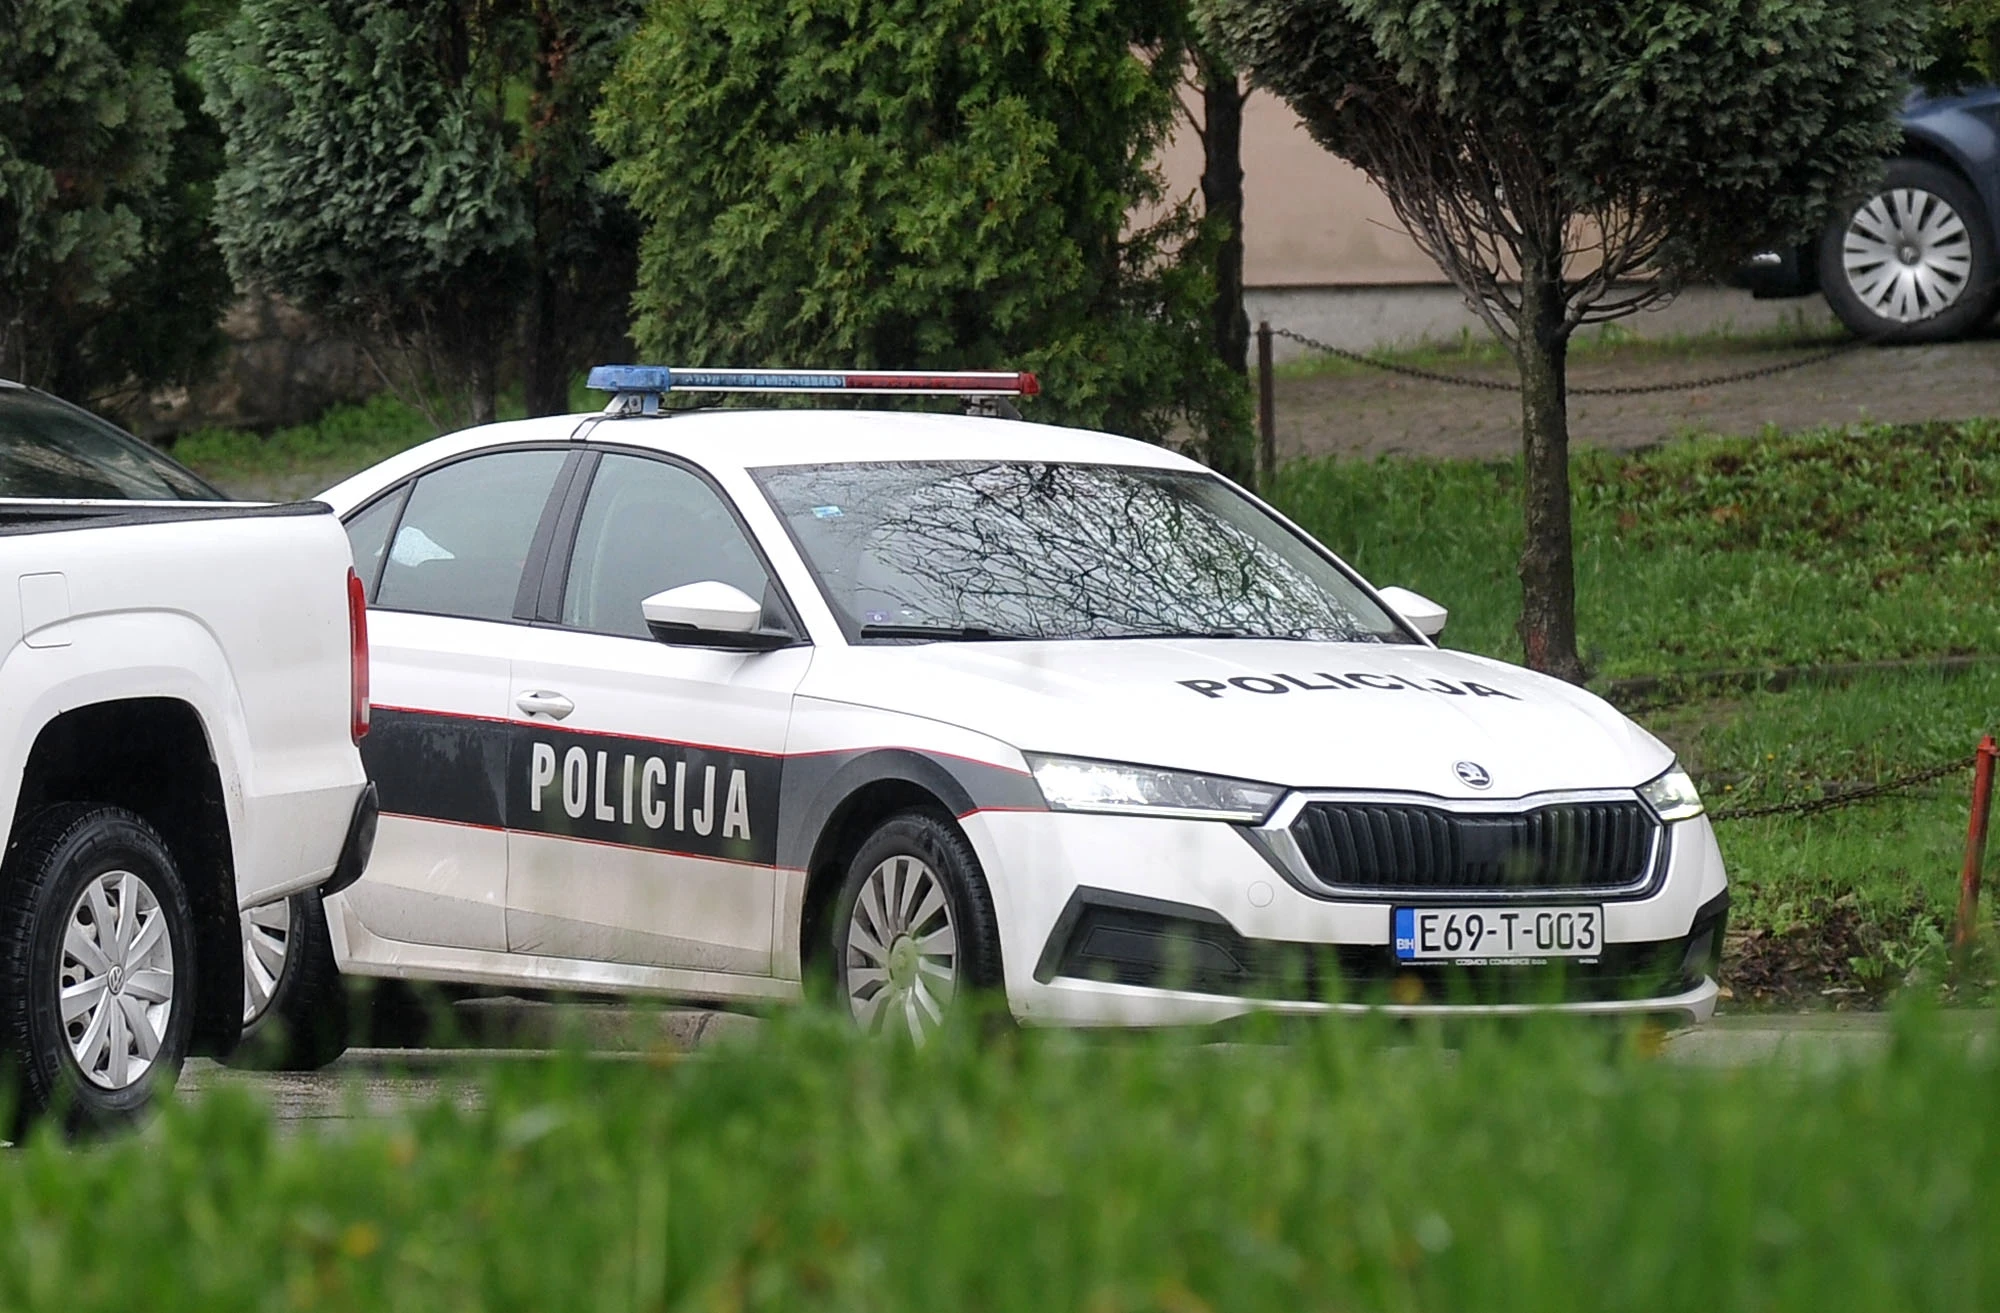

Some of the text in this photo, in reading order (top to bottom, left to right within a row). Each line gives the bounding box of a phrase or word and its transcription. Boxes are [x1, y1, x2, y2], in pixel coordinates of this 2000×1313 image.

[1175, 672, 1523, 701] POLICIJA
[530, 742, 751, 840] POLICIJA
[1420, 912, 1595, 952] E69-T-003
